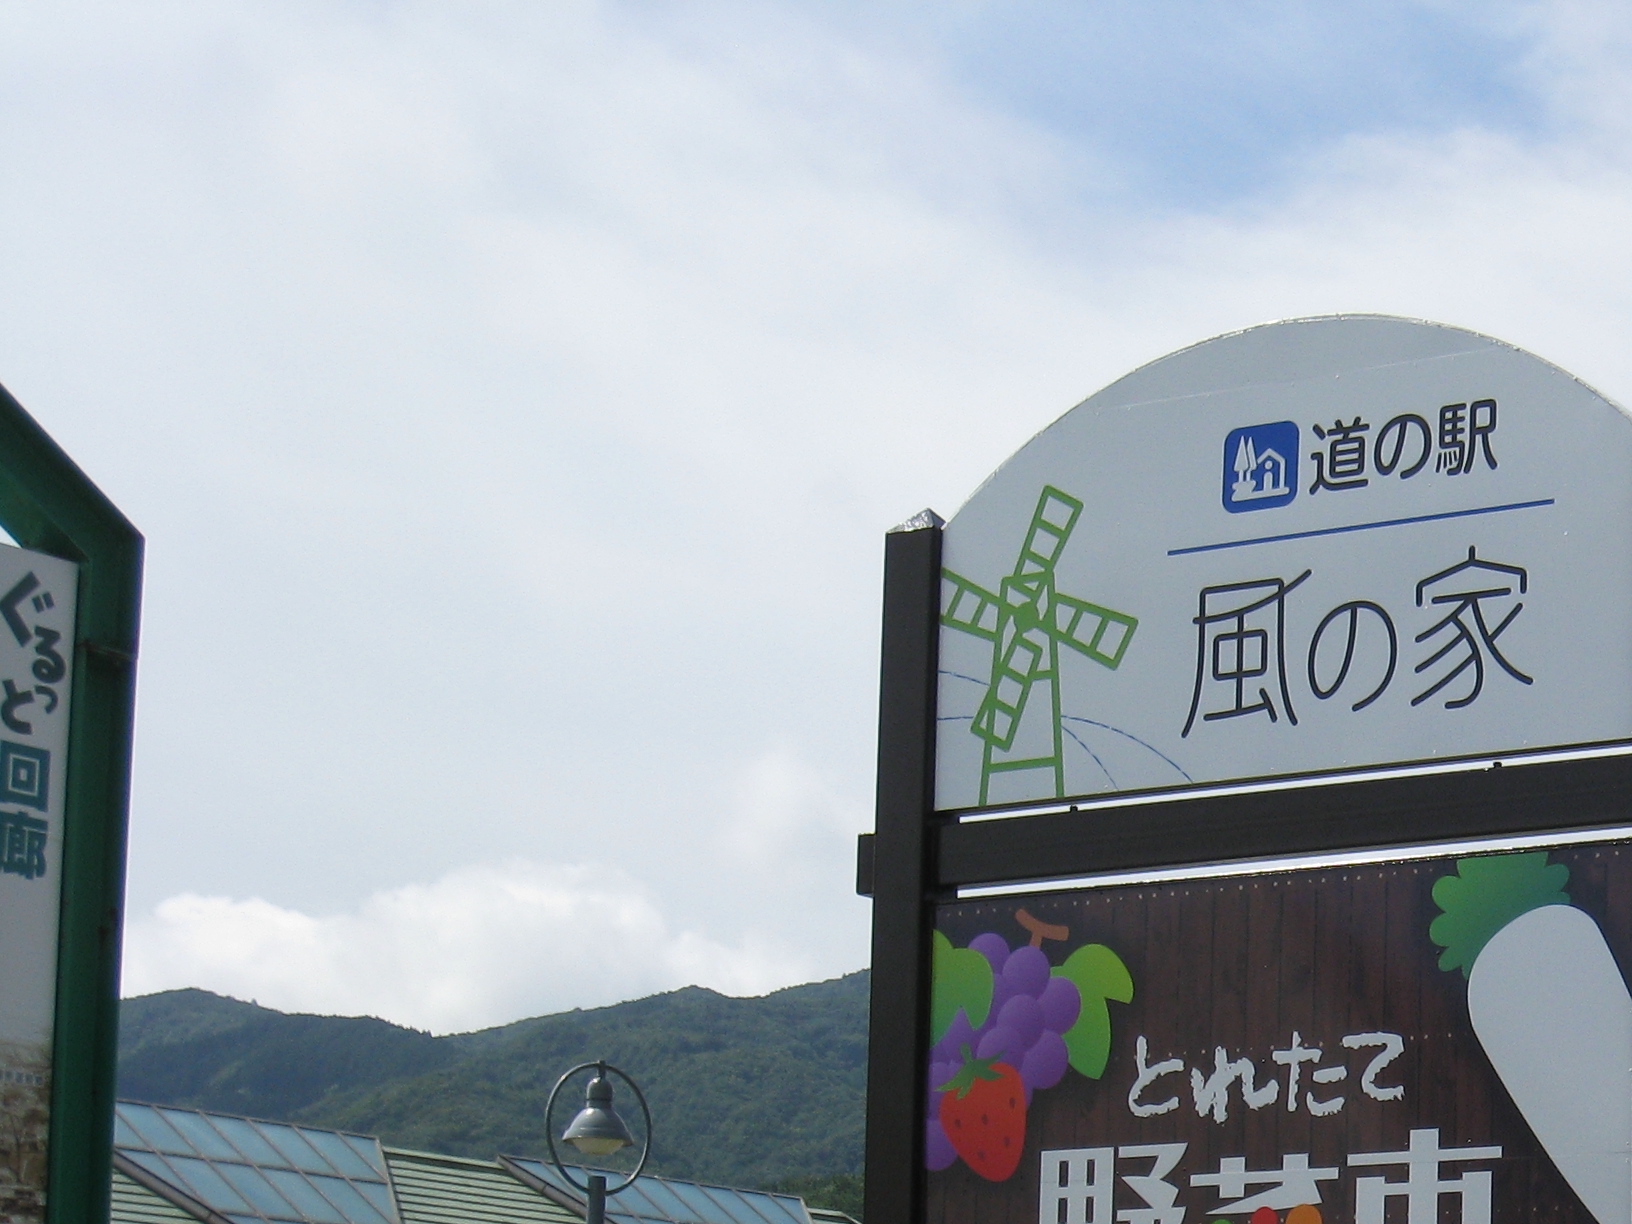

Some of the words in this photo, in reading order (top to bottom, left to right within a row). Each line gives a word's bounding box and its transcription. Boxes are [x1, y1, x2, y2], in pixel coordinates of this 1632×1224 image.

[1308, 398, 1498, 494] 道の駅
[1181, 545, 1534, 738] 風の家
[1127, 1031, 1405, 1125] とれたて
